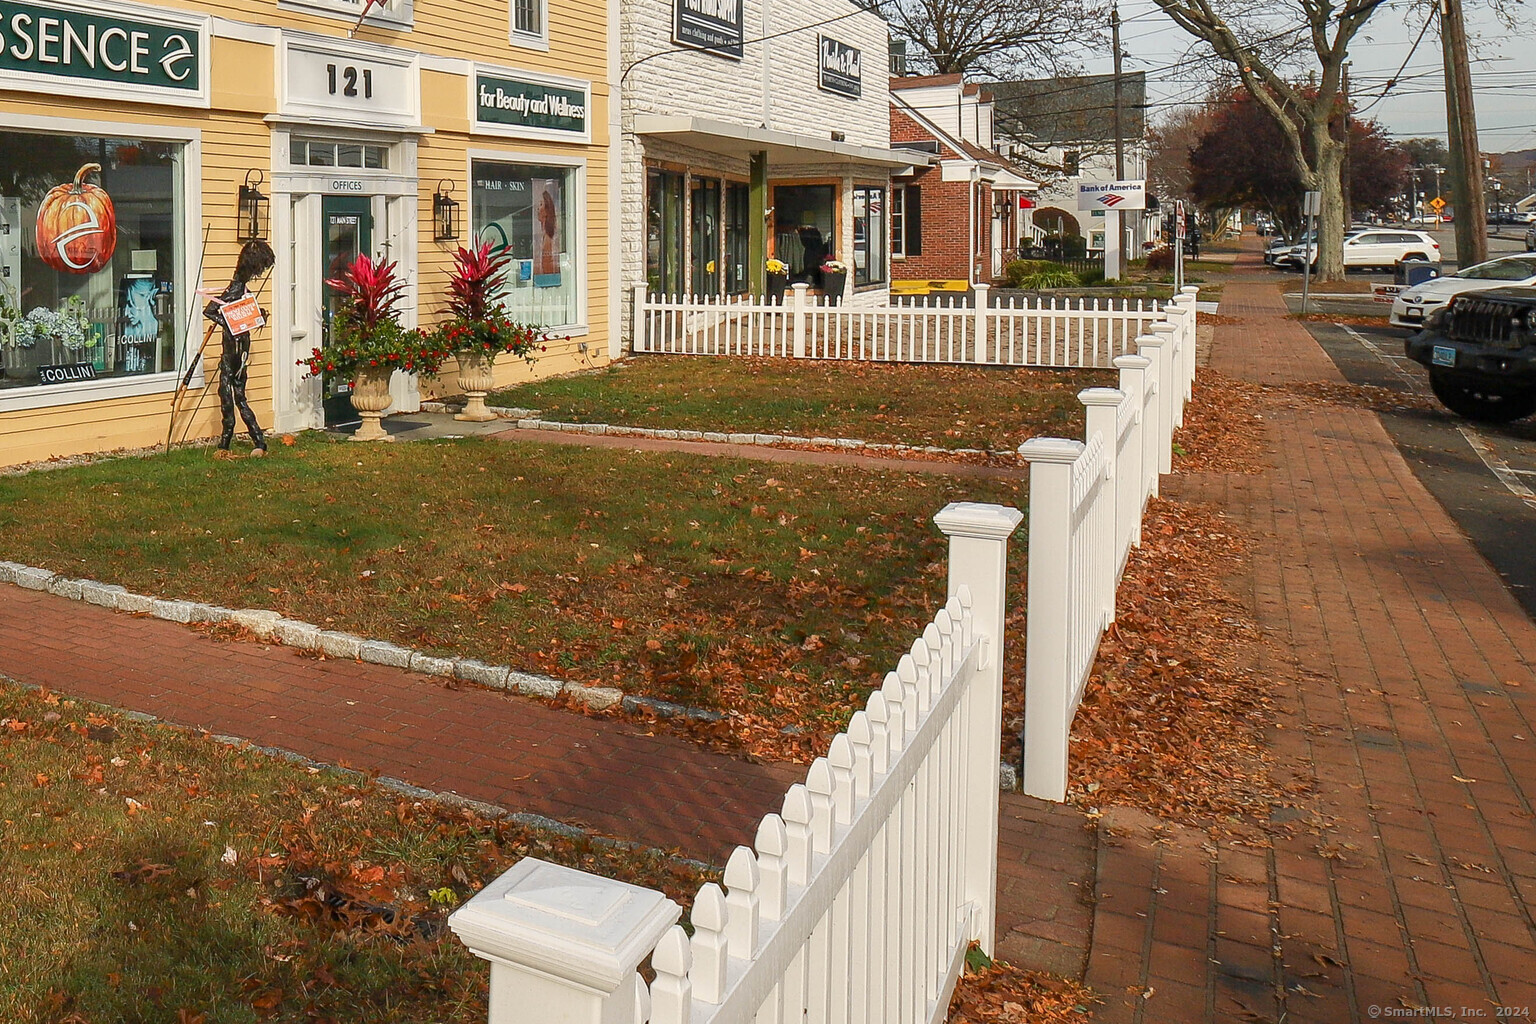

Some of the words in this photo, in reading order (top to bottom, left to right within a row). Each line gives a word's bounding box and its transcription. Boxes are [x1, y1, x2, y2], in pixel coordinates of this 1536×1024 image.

[327, 64, 372, 98] 121
[479, 84, 496, 108] for
[496, 87, 530, 117] Beauty
[530, 94, 549, 116] and
[549, 95, 584, 119] Wellness
[332, 180, 362, 191] OFFICES
[485, 180, 502, 190] HAIR
[509, 181, 525, 191] SKIN
[1109, 183, 1142, 191] America
